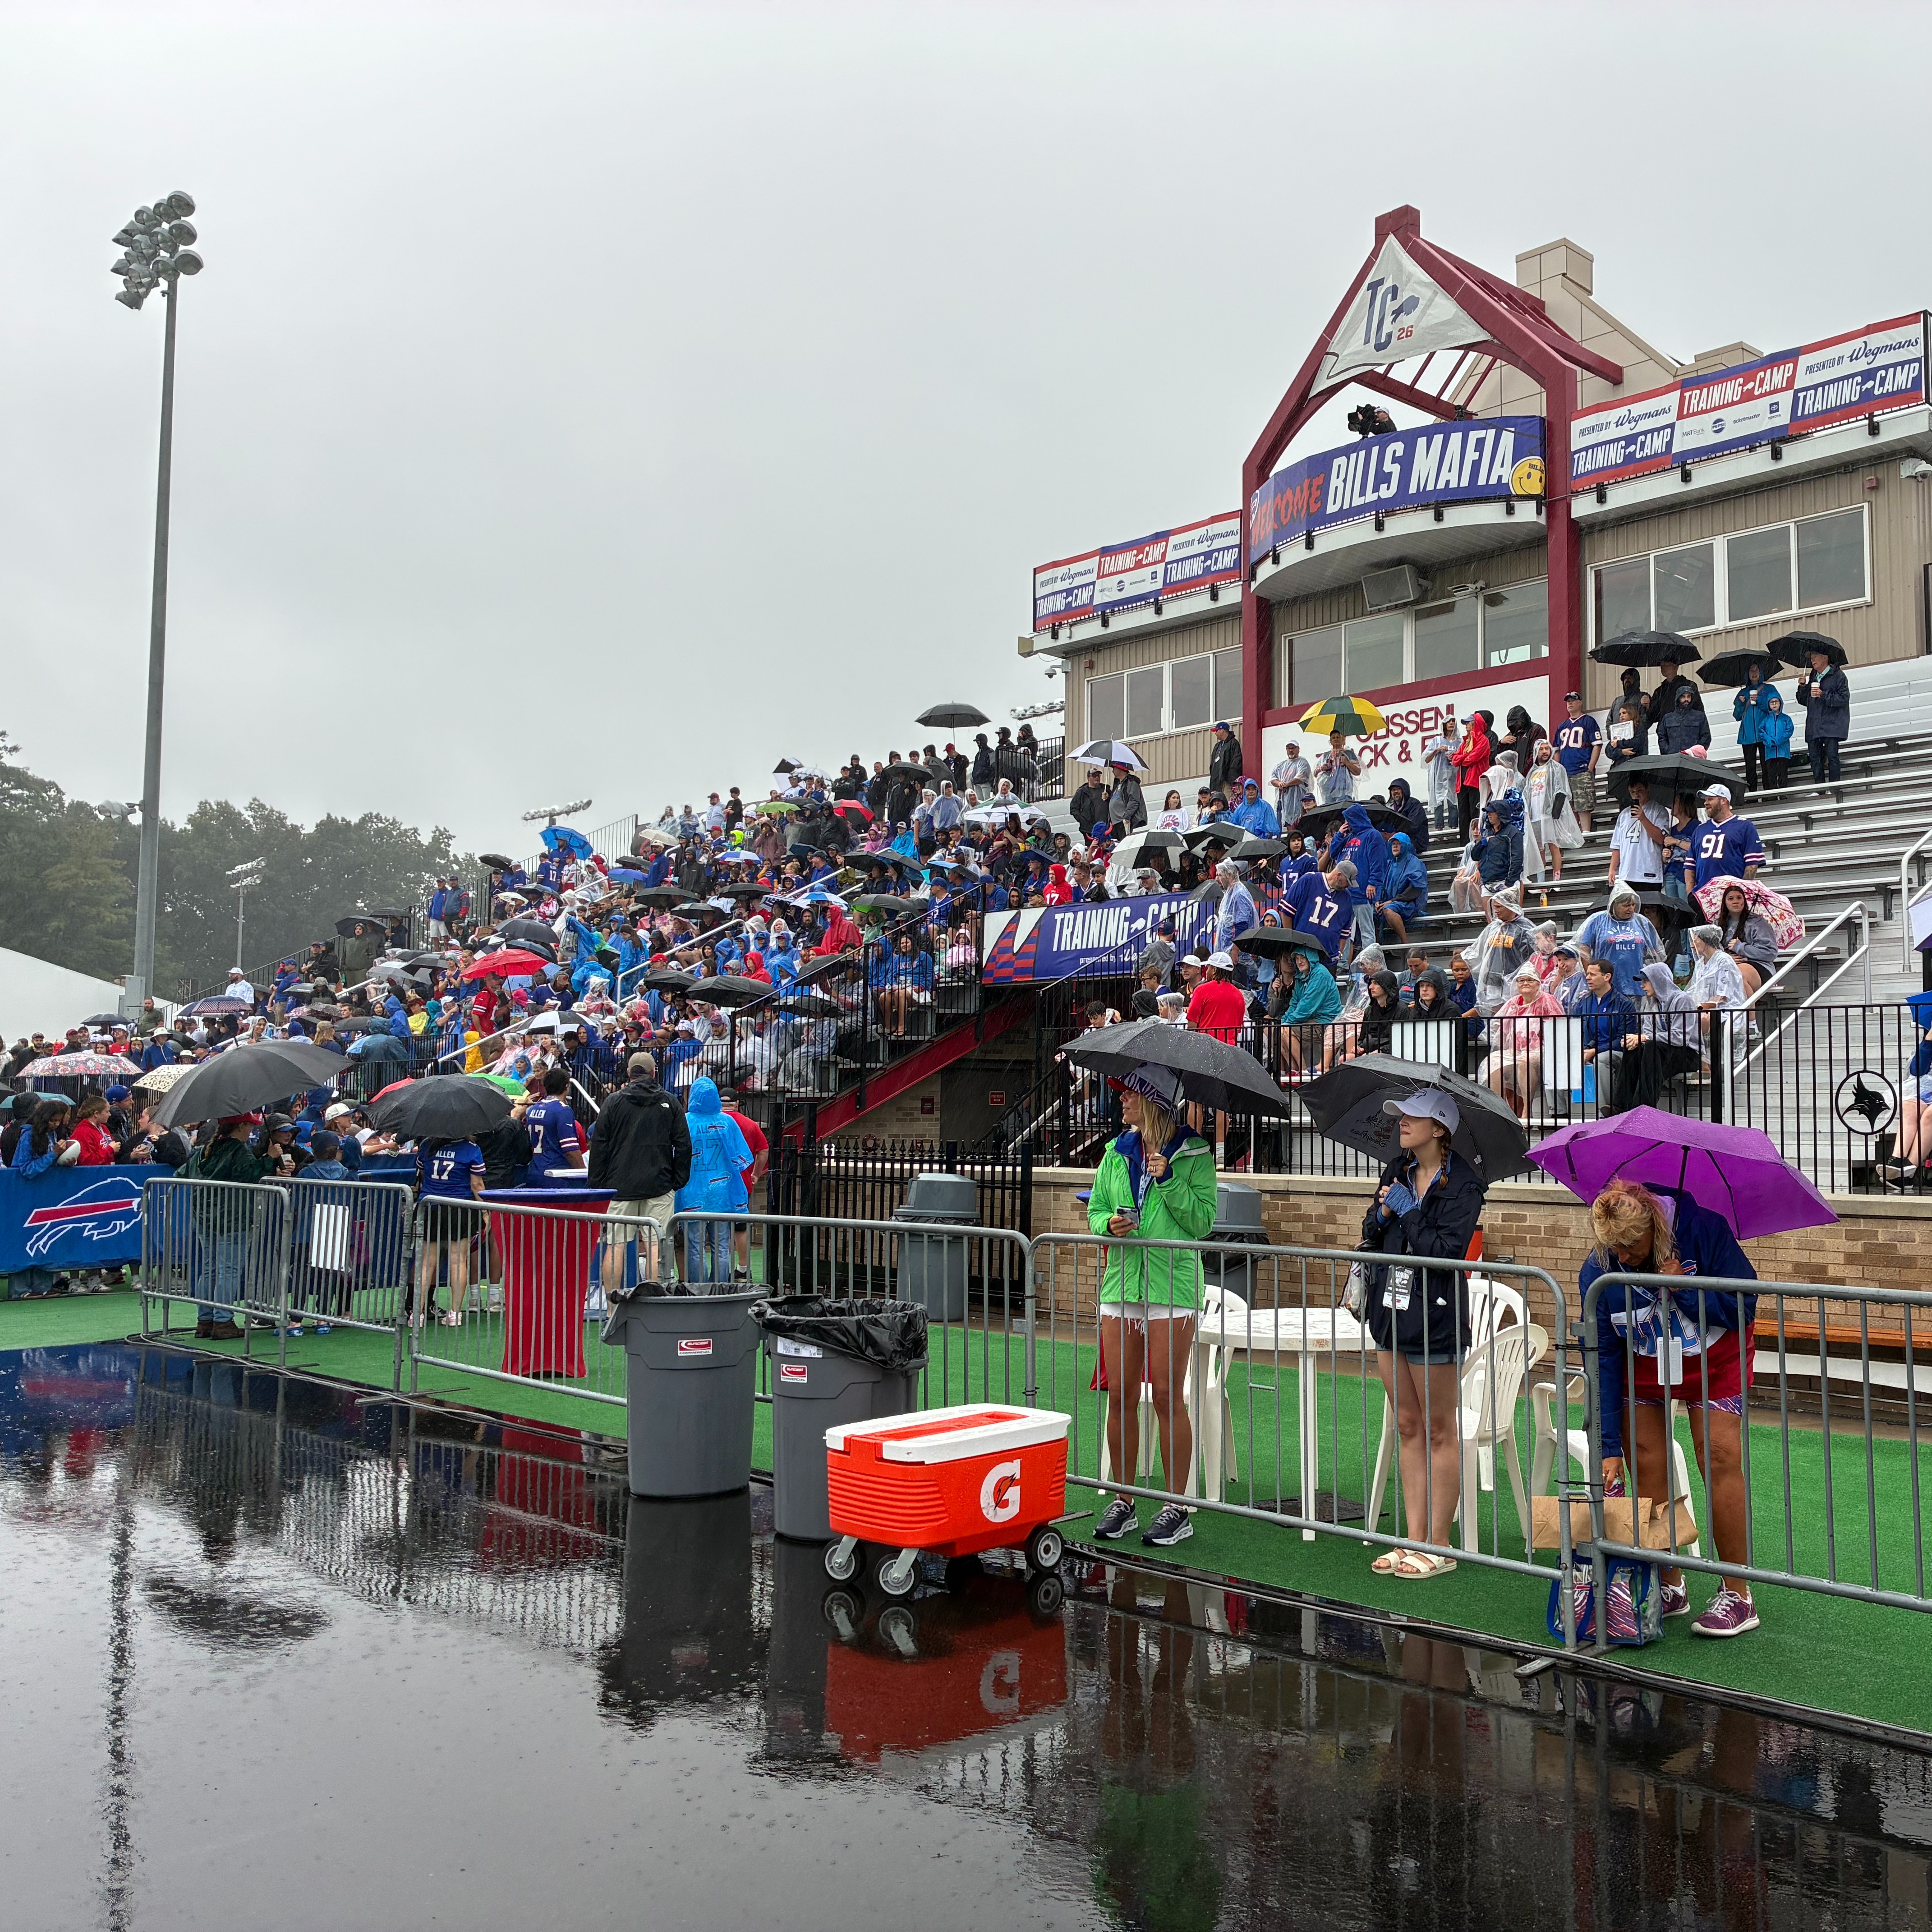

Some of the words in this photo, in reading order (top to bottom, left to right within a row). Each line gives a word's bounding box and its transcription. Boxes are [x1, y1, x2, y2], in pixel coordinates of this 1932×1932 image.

[1363, 277, 1398, 353] TC
[1397, 325, 1414, 341] 26
[1805, 358, 1836, 375] PRESENTED
[1836, 354, 1845, 366] BY
[1846, 337, 1920, 365] Wegmans
[1683, 377, 1743, 415] TRAINING
[1754, 363, 1794, 395] CAMP
[1797, 376, 1862, 417] TRAINING
[1874, 363, 1920, 396] CAMP
[1579, 423, 1605, 438] PRESENTED
[1605, 421, 1612, 430] BY
[1613, 405, 1672, 431] Wegmans
[1573, 440, 1625, 476] TRAINING
[1636, 428, 1671, 459] CAMP
[1251, 473, 1325, 546] WELCOME
[1326, 441, 1404, 515] BILLS
[1408, 427, 1515, 495] MAFIA
[1196, 529, 1239, 547] Wegmans
[1100, 550, 1137, 576] TRAINING
[1142, 542, 1166, 565] CAMP
[1167, 556, 1204, 583] TRAINING
[1211, 548, 1238, 571] CAMP
[1060, 567, 1094, 585] Wegmans
[1037, 592, 1066, 618] TRAINING
[1072, 585, 1093, 607] CAMP
[1625, 819, 1641, 843] 4
[1701, 834, 1725, 858] 91
[549, 870, 557, 881] 17
[1283, 873, 1298, 895] 17
[1046, 893, 1059, 905] 17
[1309, 896, 1339, 928] 17
[1053, 906, 1131, 952] TRAINING
[529, 1109, 546, 1118] ALLEN
[436, 1150, 455, 1159] ALLEN
[528, 1124, 544, 1153] 17
[431, 1160, 455, 1180] 17
[693, 1138, 722, 1172] 17
[980, 1458, 1022, 1523] G
